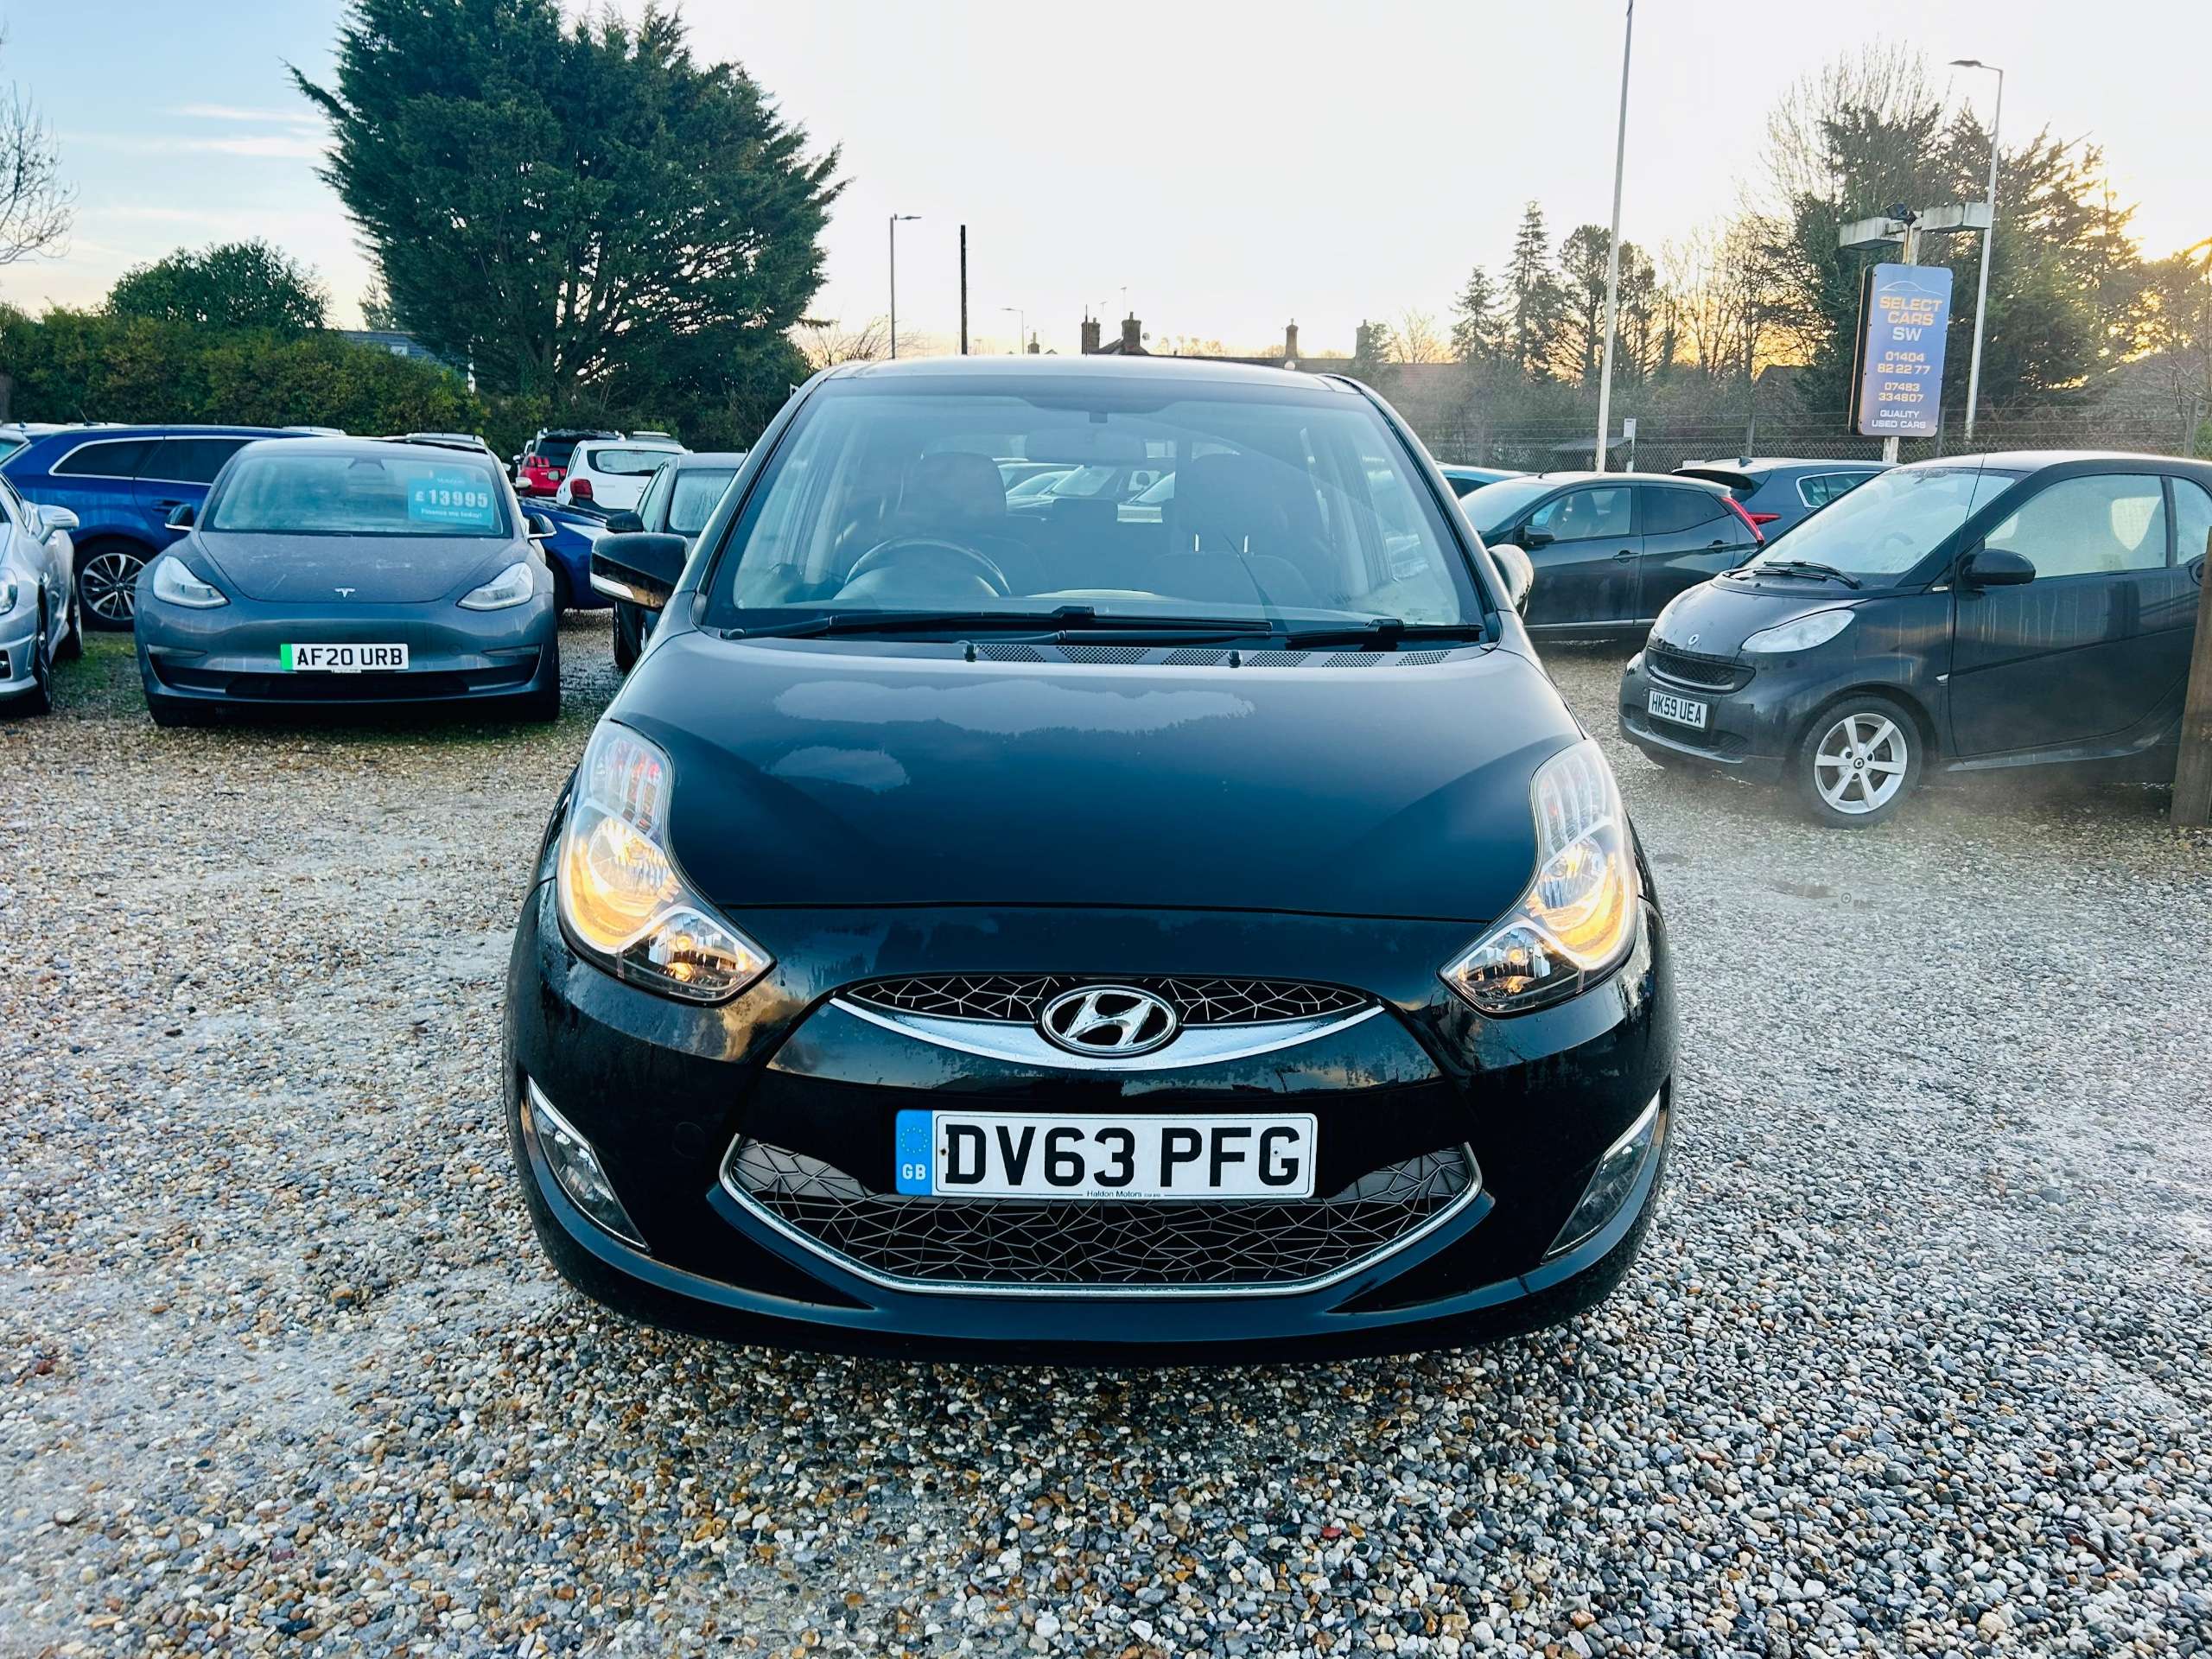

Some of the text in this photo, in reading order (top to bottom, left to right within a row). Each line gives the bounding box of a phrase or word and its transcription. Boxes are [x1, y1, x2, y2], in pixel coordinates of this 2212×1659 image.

[1879, 296, 1943, 312] SELECT
[1887, 311, 1935, 326] CARS
[1892, 327, 1922, 341] SW
[1885, 351, 1925, 362] 01404
[1885, 382, 1920, 391] 07483
[1878, 392, 1924, 402] 334807
[1879, 410, 1920, 418] QUALITY
[1872, 419, 1926, 429] USED CARS
[297, 648, 404, 665] AF20 URB
[1651, 693, 1701, 724] HK59 UEA
[945, 1124, 1300, 1187] DV63 PFG
[902, 1163, 926, 1180] GB
